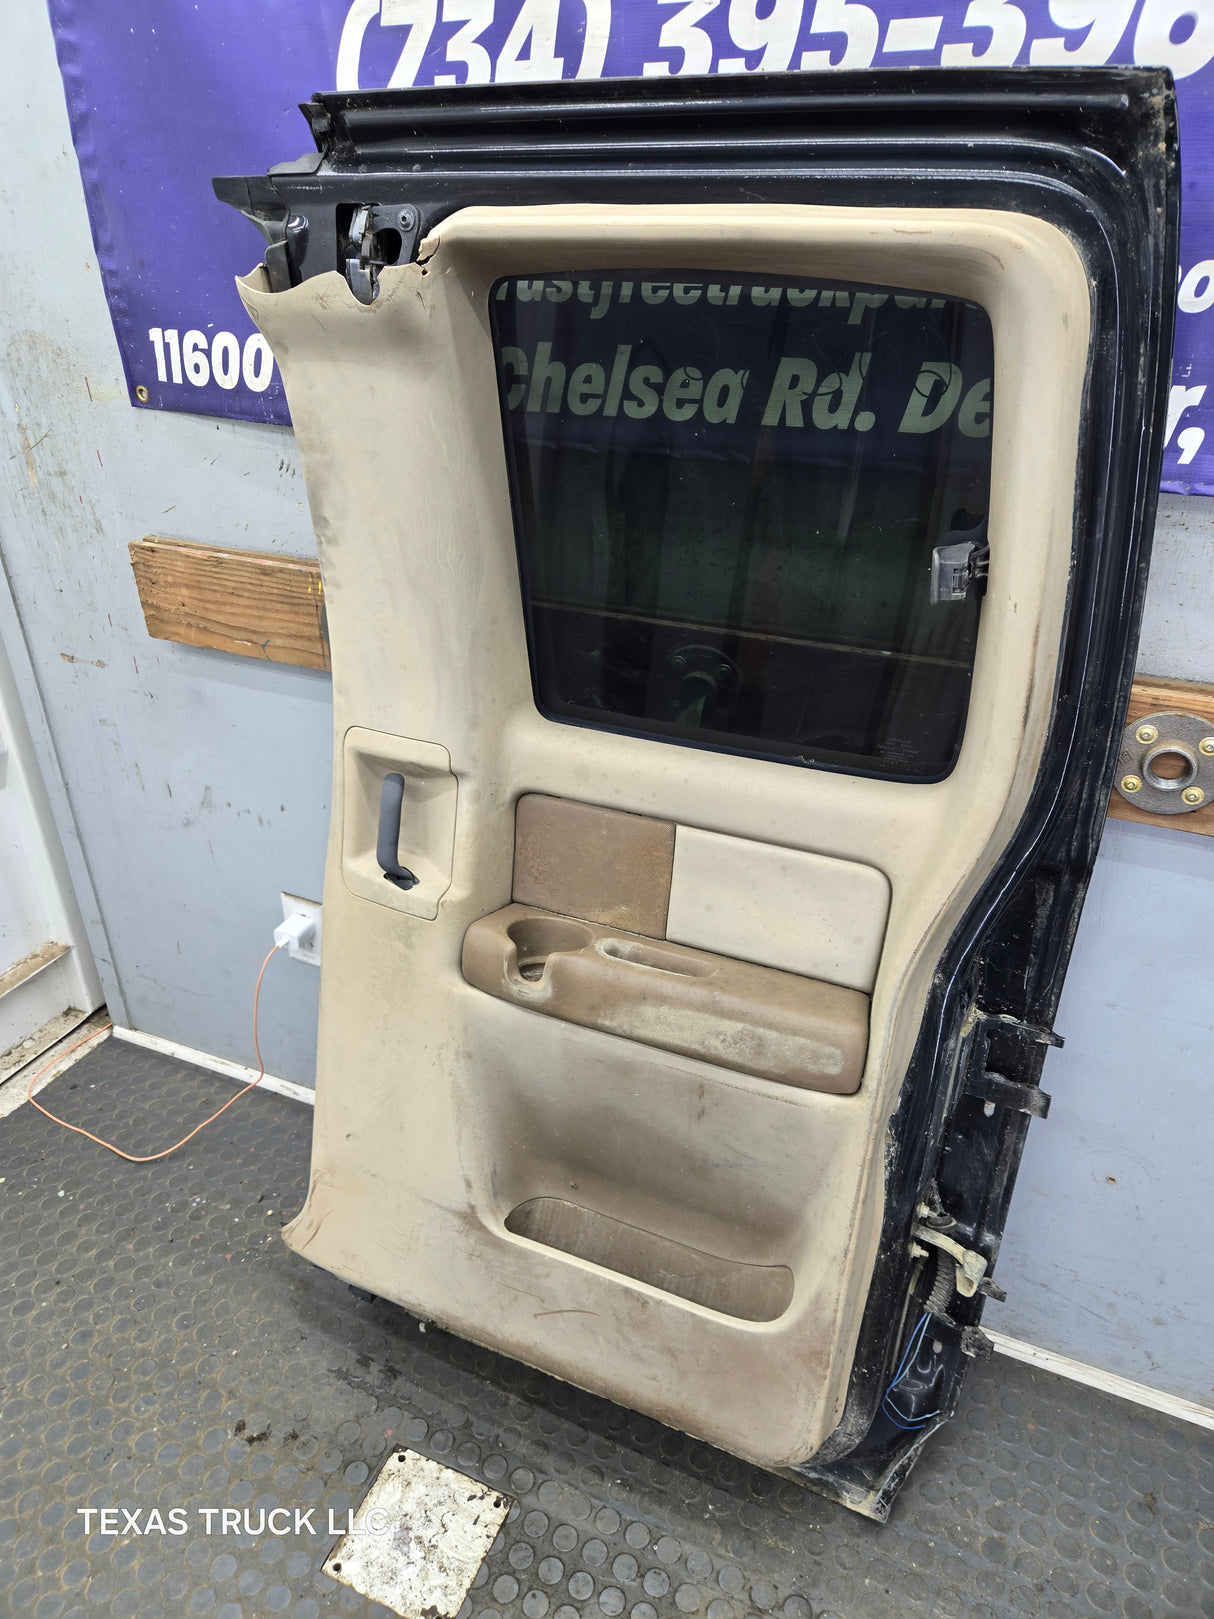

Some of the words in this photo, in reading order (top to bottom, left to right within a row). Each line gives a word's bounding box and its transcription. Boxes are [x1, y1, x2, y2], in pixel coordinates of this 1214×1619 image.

[336, 0, 612, 91] (734)
[149, 327, 274, 392] 11600
[501, 342, 750, 421] Chelsea
[761, 352, 876, 432] Rd.
